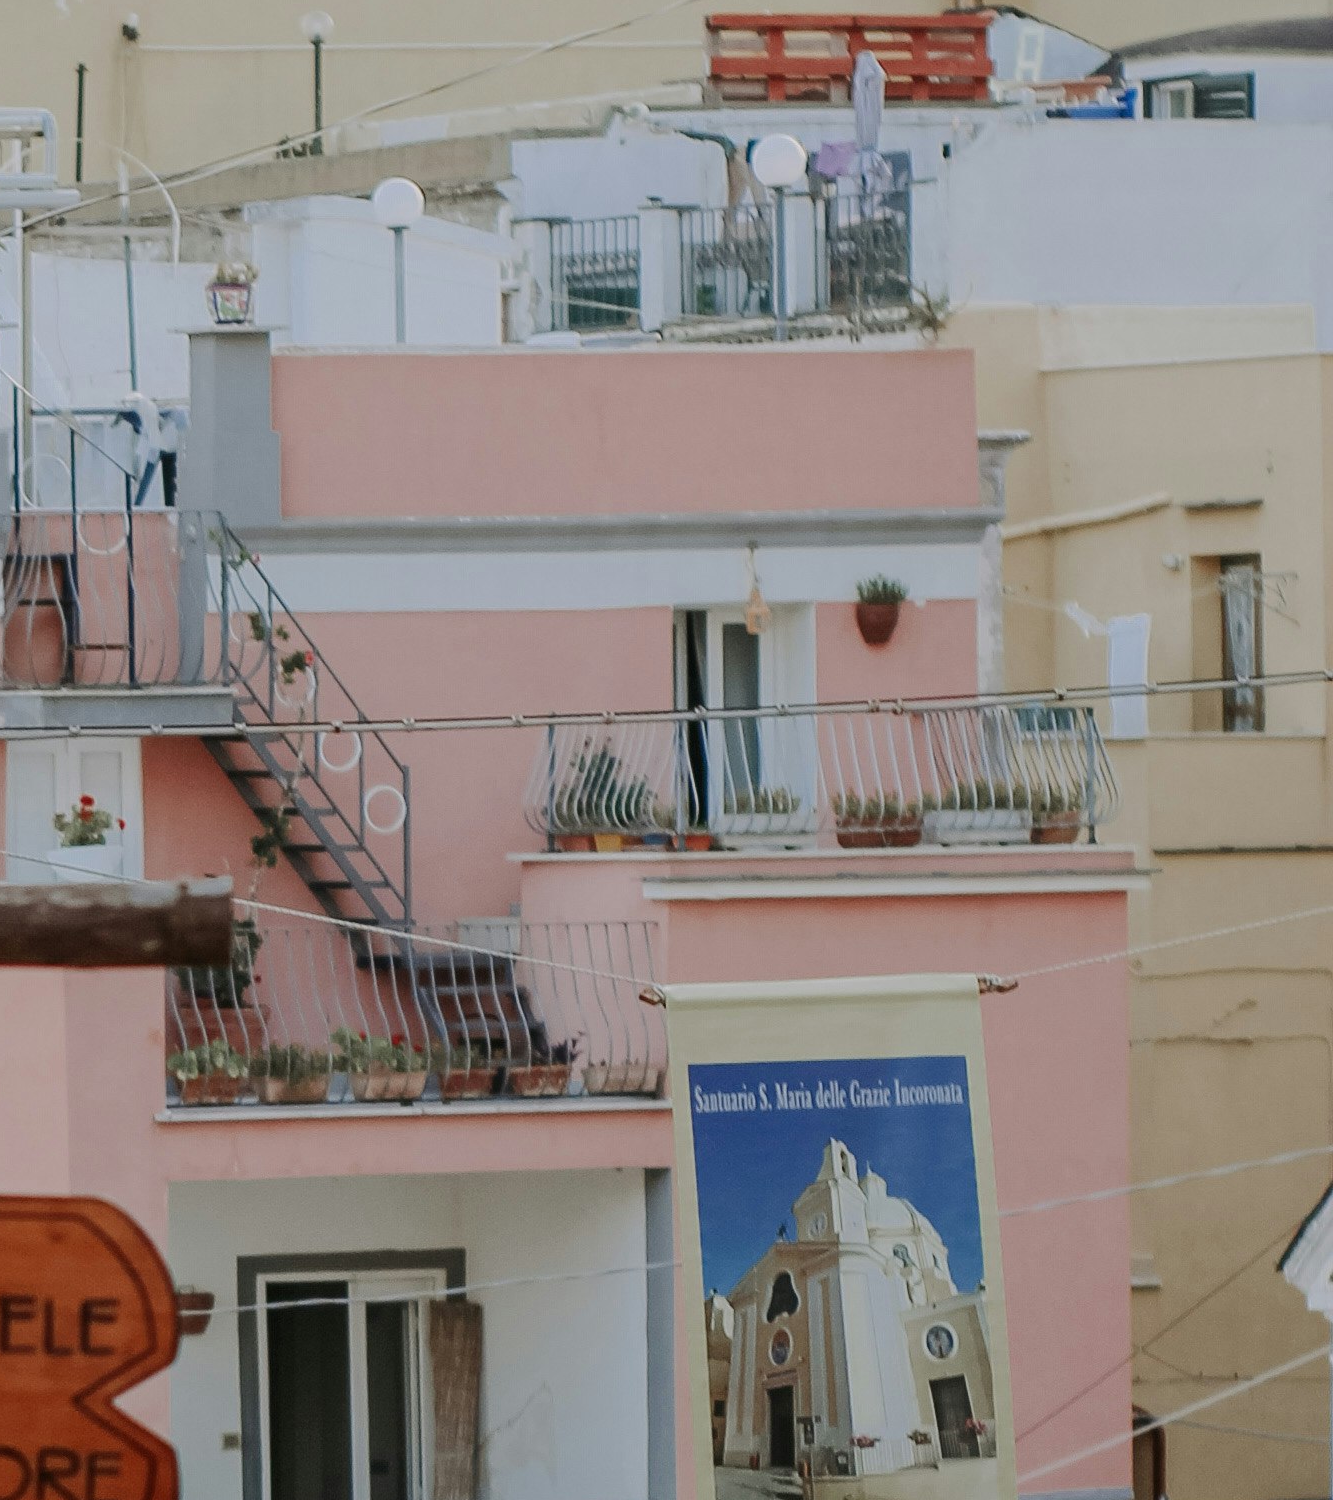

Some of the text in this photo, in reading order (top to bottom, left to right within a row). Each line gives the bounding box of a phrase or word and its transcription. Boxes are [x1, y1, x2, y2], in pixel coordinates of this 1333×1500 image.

[694, 1078, 963, 1113] Santuario S. Maria delle Grazie Incoronata
